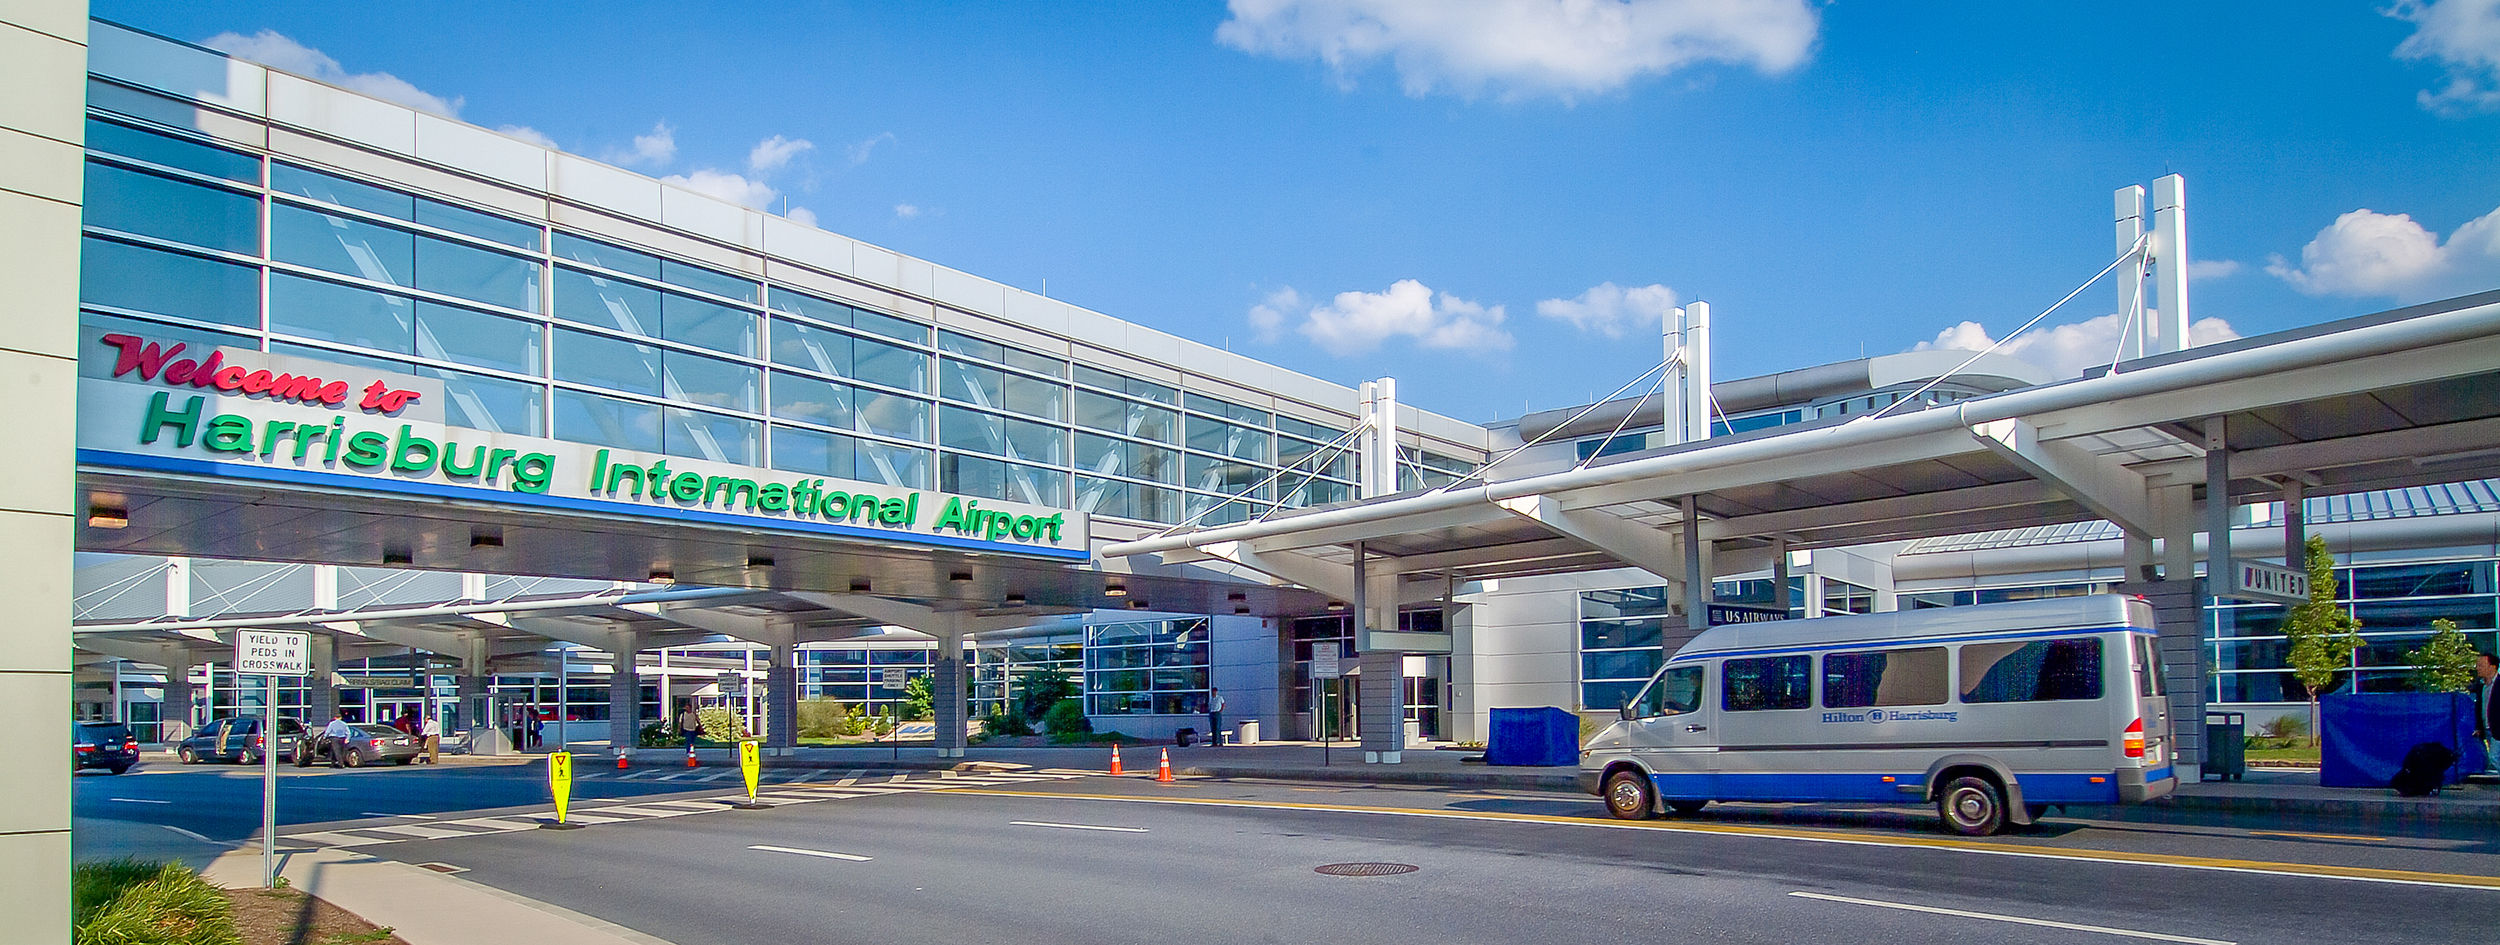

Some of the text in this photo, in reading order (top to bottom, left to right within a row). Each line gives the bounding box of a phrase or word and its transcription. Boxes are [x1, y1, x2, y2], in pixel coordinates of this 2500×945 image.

[102, 333, 421, 412] Welcome to
[142, 391, 1064, 541] Harrisburg International Airport
[2255, 568, 2304, 595] UNITED
[1742, 611, 1785, 623] AIRWAYS
[249, 635, 298, 646] YIELD TO
[251, 647, 295, 658] PEDS IN
[242, 660, 302, 670] CROSSWALK
[1822, 712, 1864, 723] Hilton
[1889, 710, 1958, 722] Harrisburg
